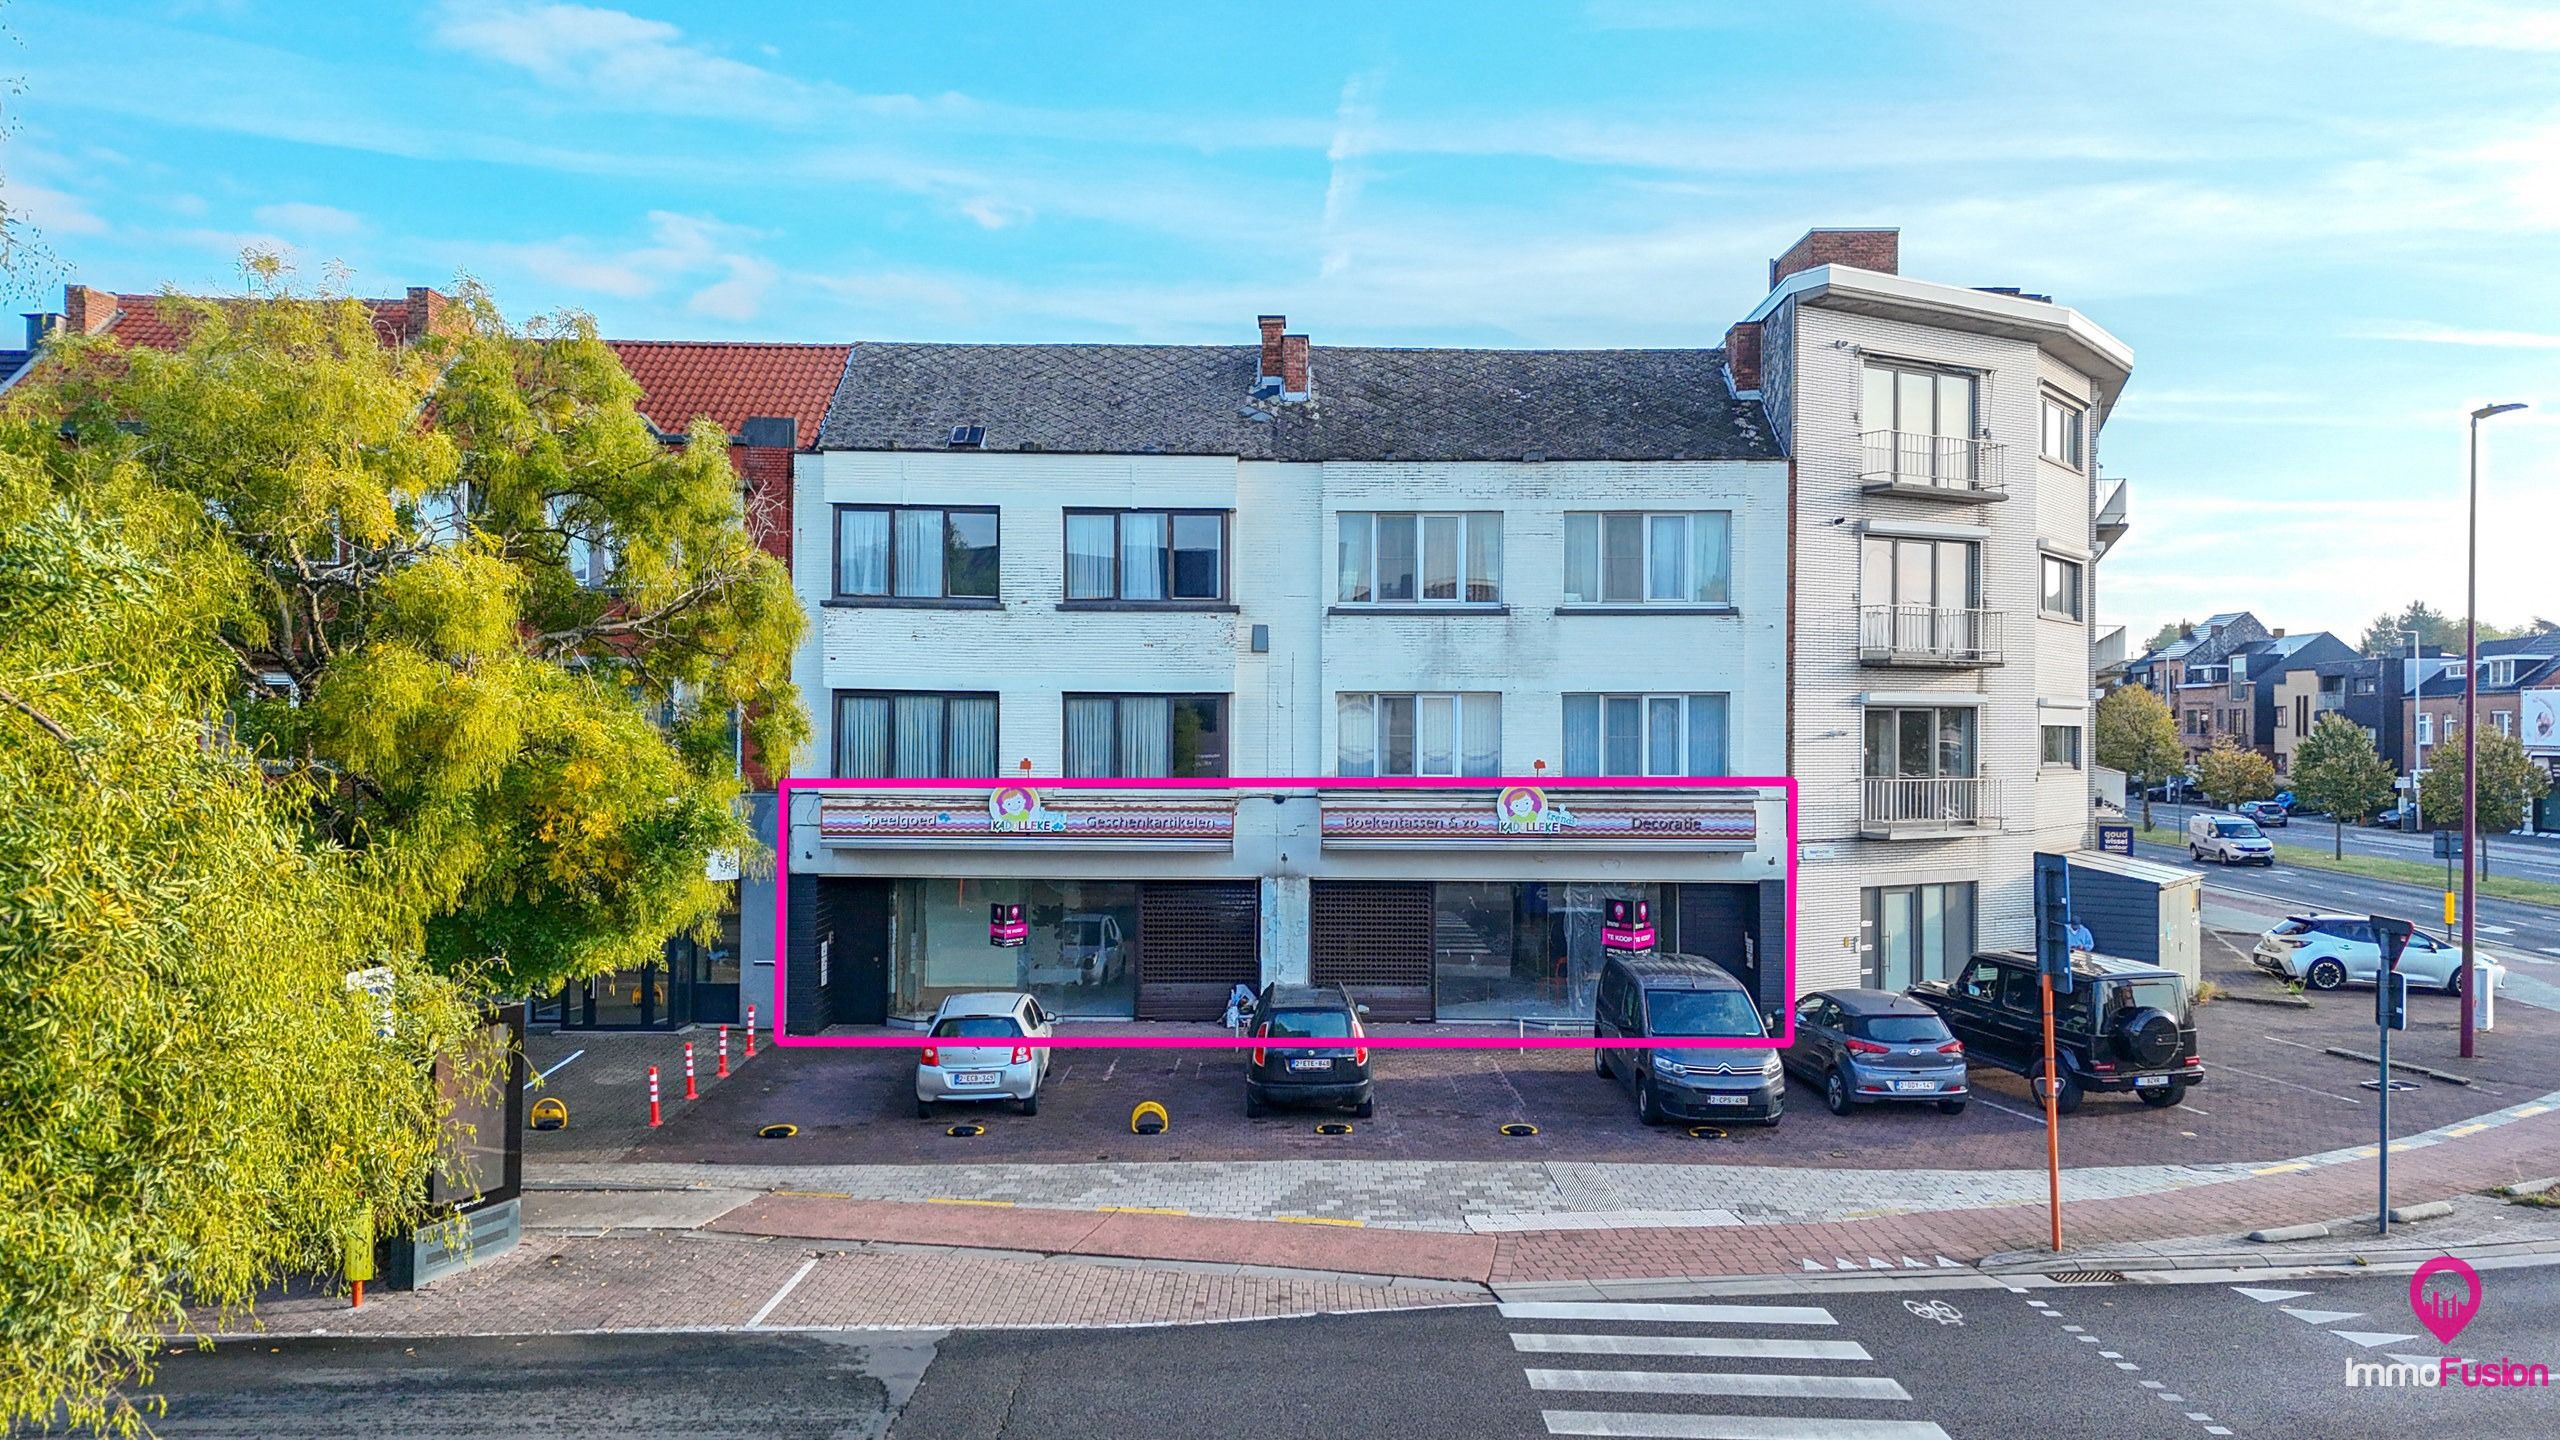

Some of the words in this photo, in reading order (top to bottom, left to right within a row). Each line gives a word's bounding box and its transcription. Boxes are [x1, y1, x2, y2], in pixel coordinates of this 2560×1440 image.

[861, 814, 937, 829] Speelgoed
[1086, 816, 1216, 829] Geschenkartikelen
[1345, 816, 1444, 830] Boekentassen
[1448, 817, 1459, 830] &
[1463, 820, 1480, 830] zo
[1631, 818, 1702, 831] Decoratie
[2104, 830, 2128, 839] goud
[1607, 933, 1615, 941] TE
